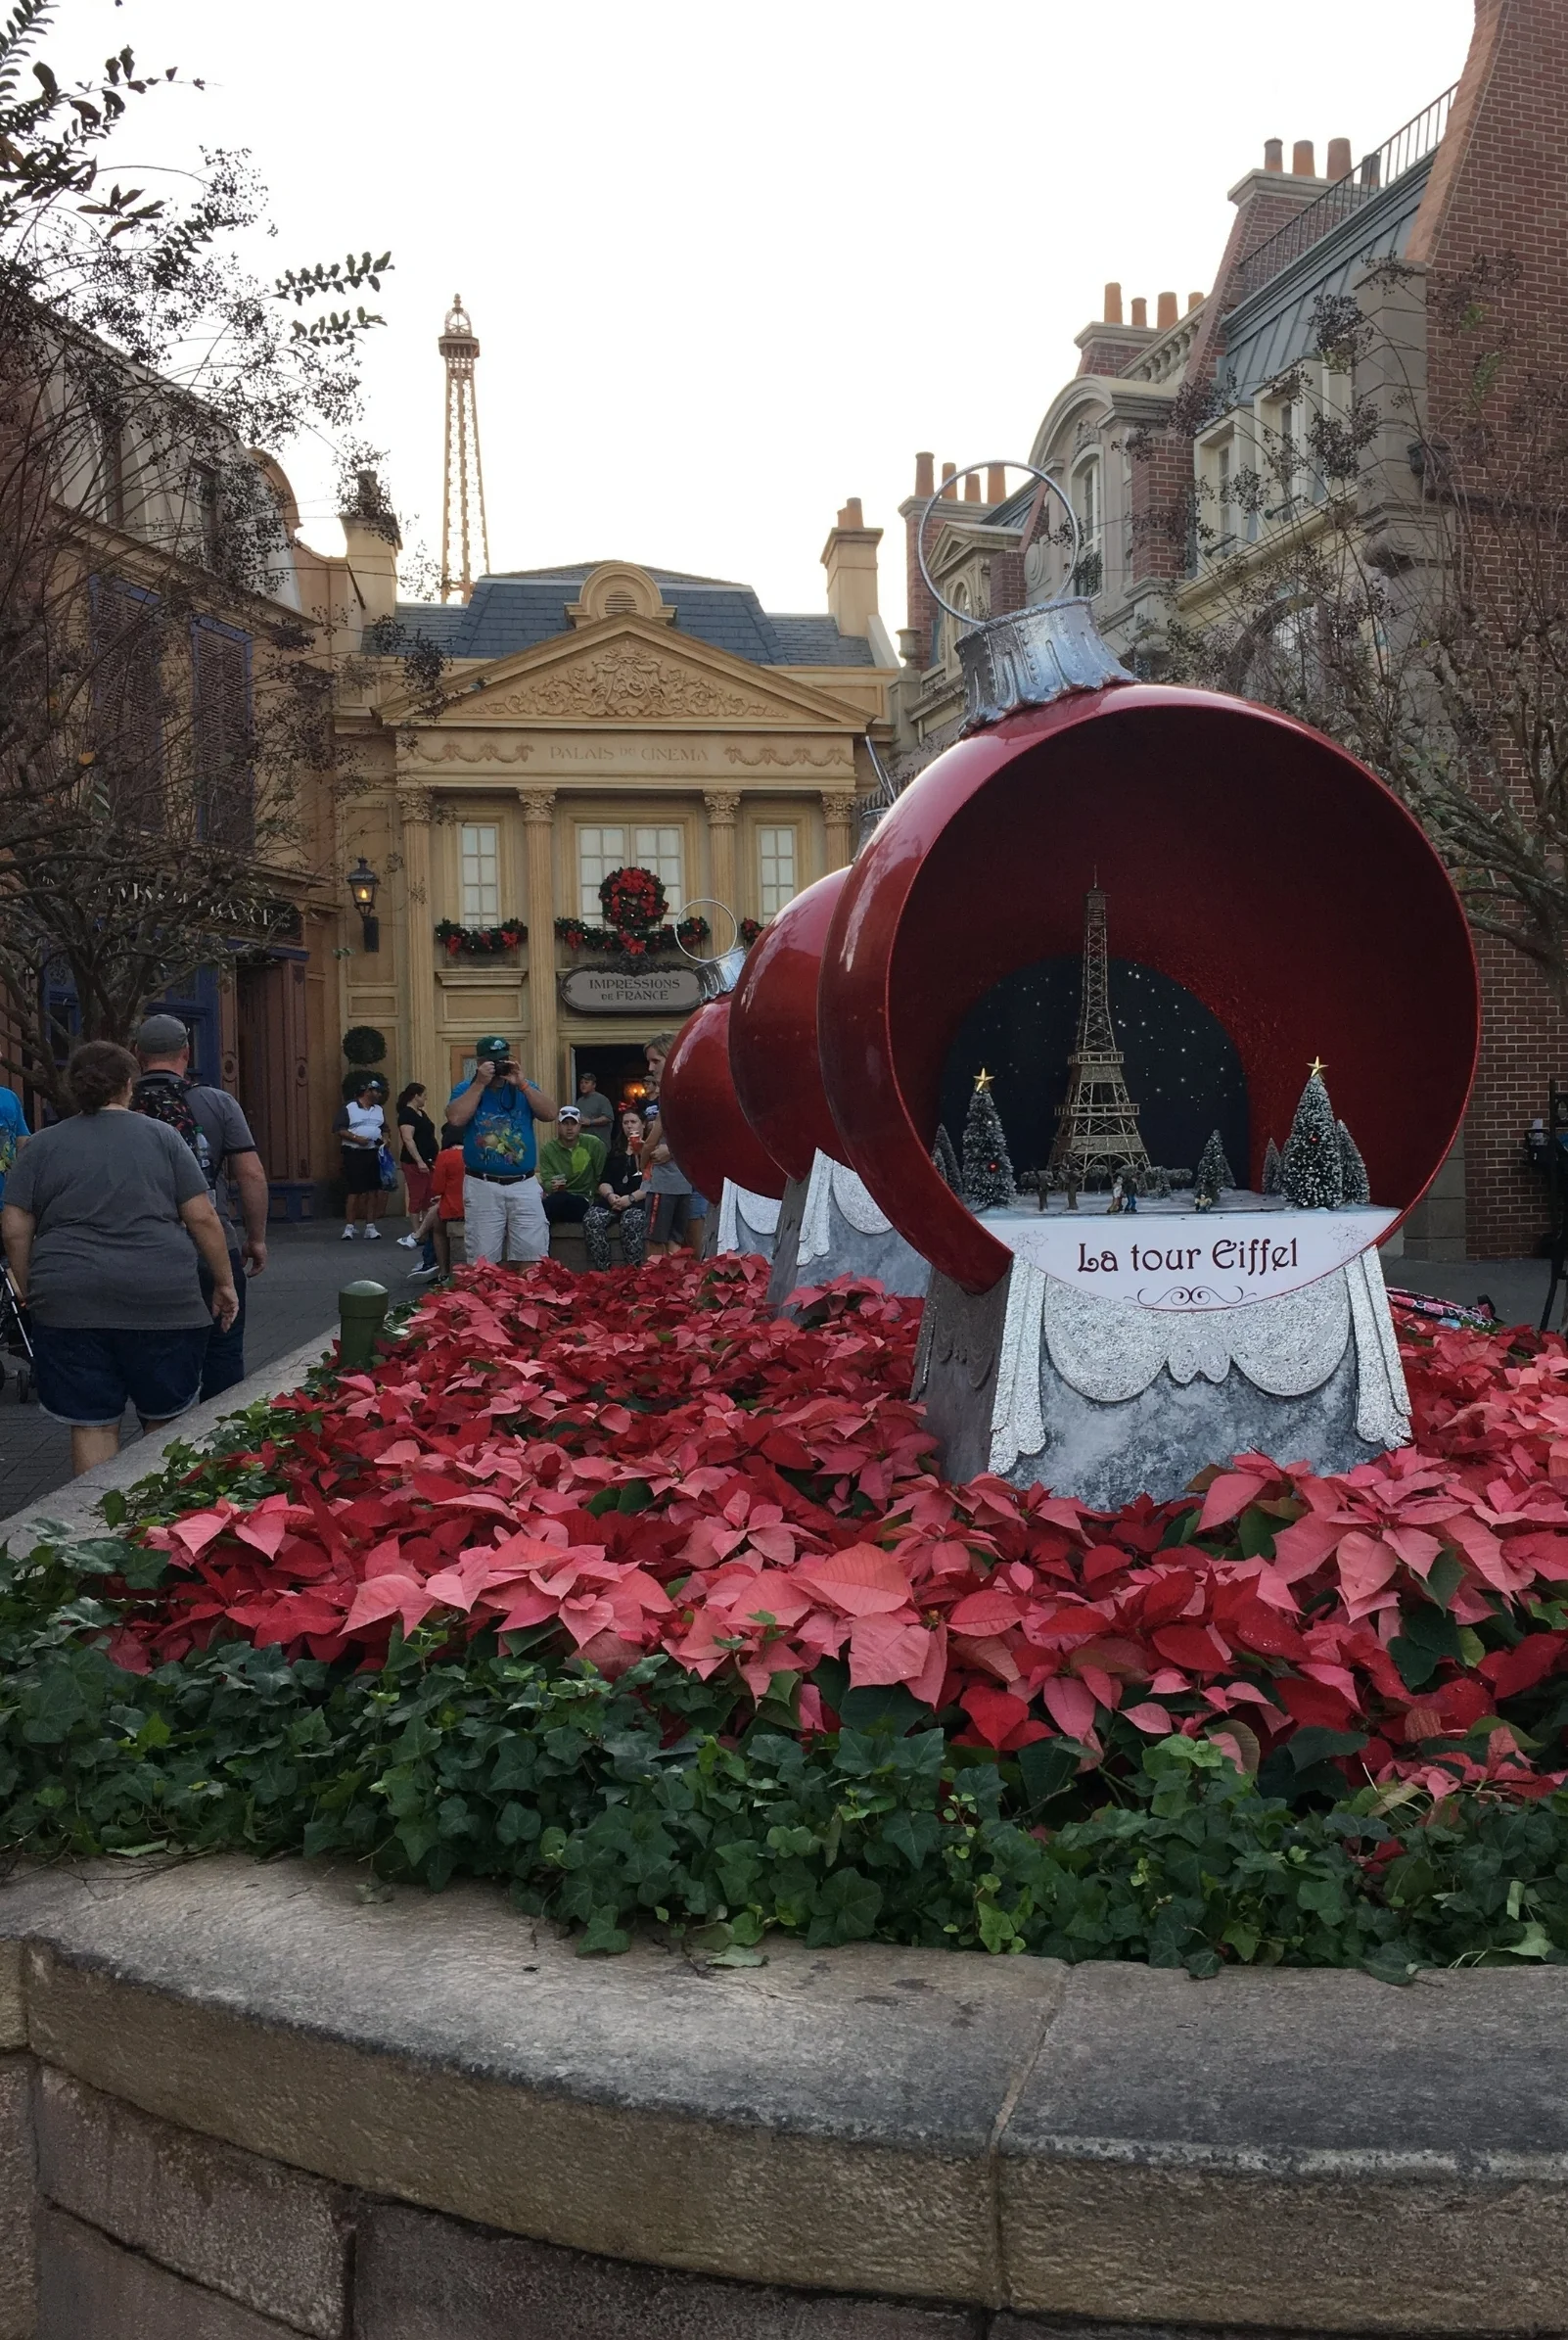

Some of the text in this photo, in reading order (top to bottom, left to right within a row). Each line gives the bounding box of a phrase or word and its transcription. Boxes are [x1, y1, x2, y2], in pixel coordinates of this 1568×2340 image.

[550, 746, 615, 760] PALAIS
[641, 748, 709, 761] CINEMA
[589, 979, 680, 989] IMPRESSIONS
[617, 990, 669, 1001] FRANCE
[1078, 1238, 1298, 1276] La tour Eiffel
